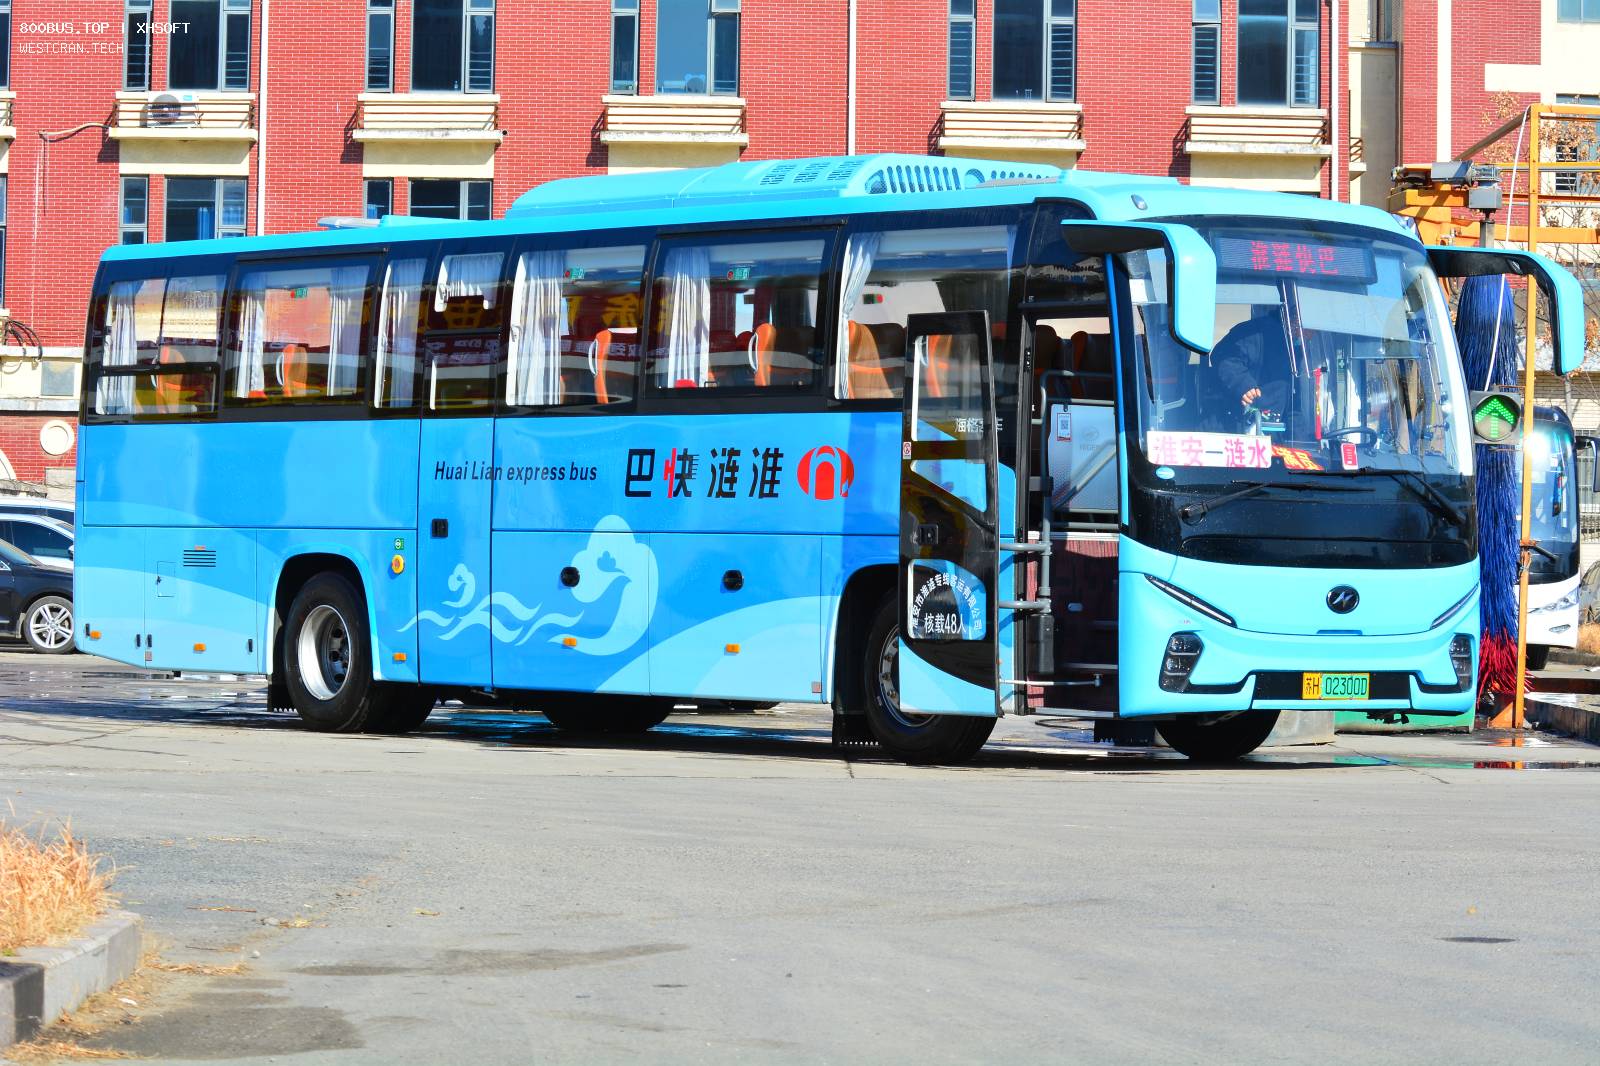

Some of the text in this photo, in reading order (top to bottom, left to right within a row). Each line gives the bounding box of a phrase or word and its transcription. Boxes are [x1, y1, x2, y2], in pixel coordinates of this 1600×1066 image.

[434, 461, 597, 484] Huai Lian express bus
[924, 612, 967, 634] 核载48人
